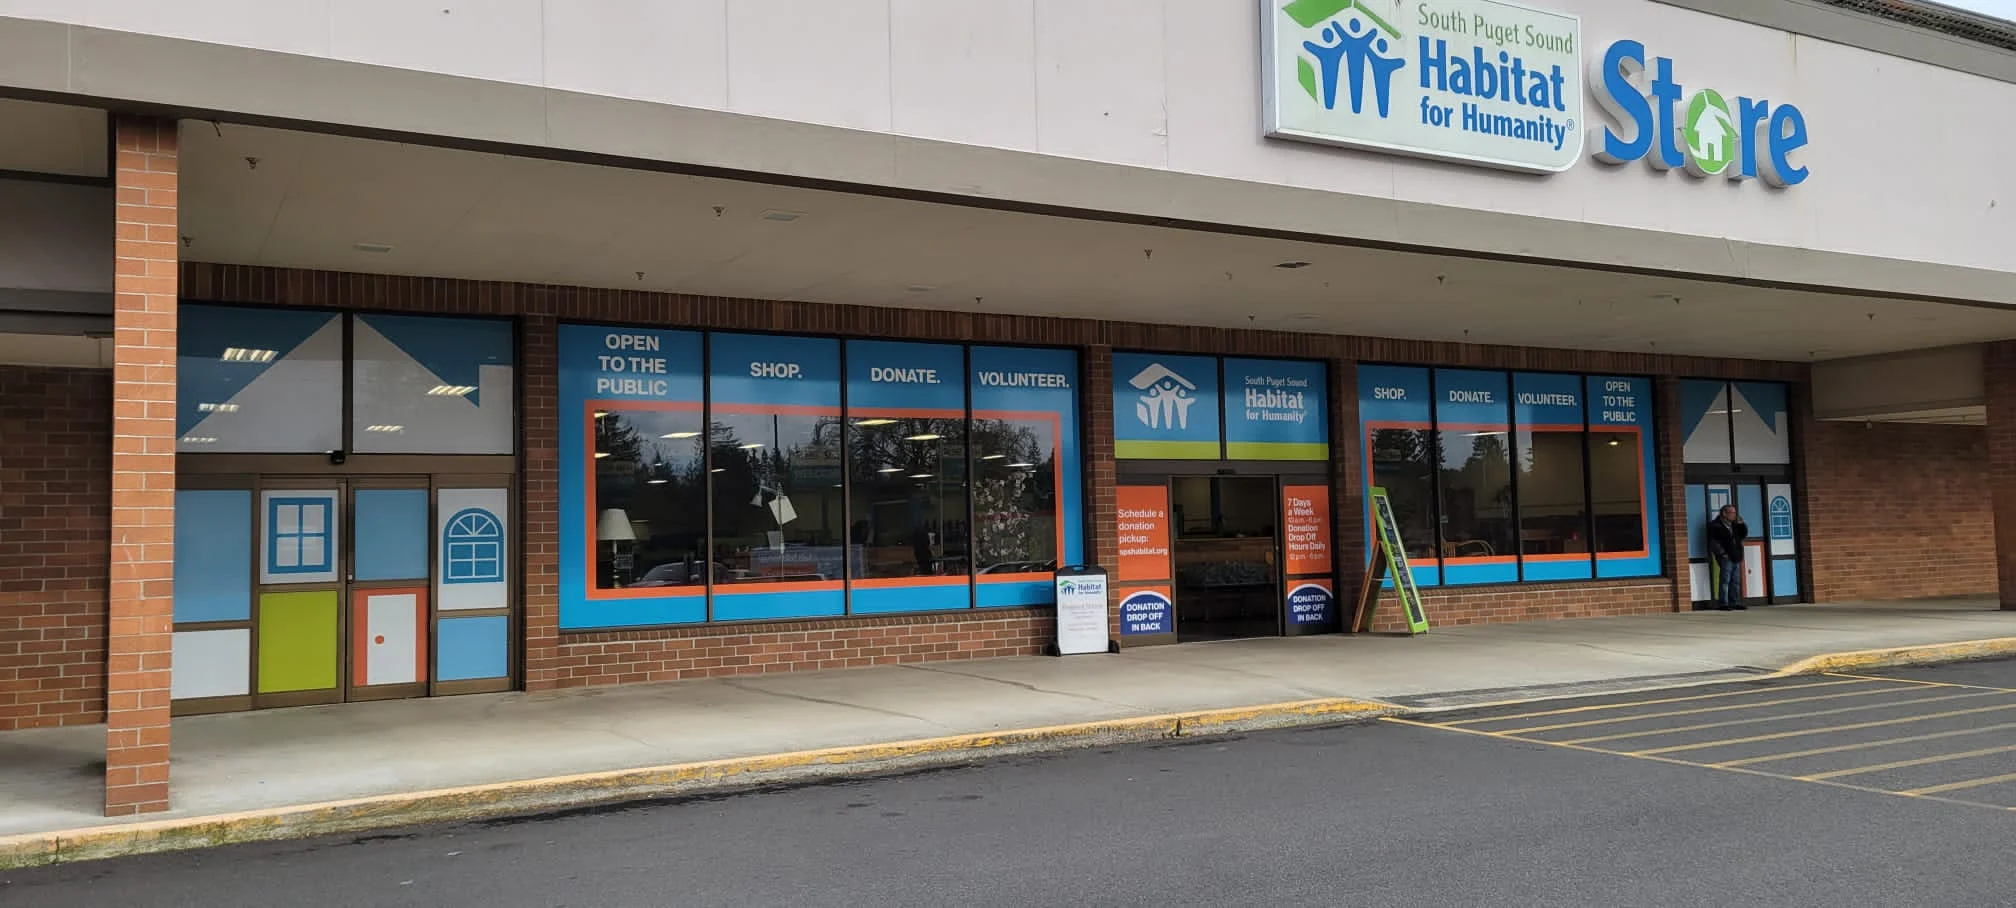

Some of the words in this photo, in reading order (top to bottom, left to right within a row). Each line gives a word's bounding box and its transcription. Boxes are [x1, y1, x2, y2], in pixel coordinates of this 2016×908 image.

[1418, 3, 1466, 34] South
[1473, 13, 1521, 46] Puget
[1525, 24, 1573, 54] Sound
[1418, 35, 1566, 112] Habitat
[1420, 95, 1453, 128] for
[1600, 38, 1810, 186] Store
[605, 333, 659, 351] OPEN
[598, 356, 625, 372] TO
[628, 357, 667, 374] THE
[750, 361, 803, 379] SHOP.
[870, 367, 941, 384] DONATE.
[978, 371, 1070, 388] VOLUNTEER.
[597, 378, 668, 396] PUBLIC
[1244, 375, 1265, 385] South
[1266, 376, 1285, 388] Puget
[1286, 376, 1308, 388] Sound
[1605, 381, 1631, 392] OPEN
[1245, 387, 1304, 409] Habitat
[1374, 387, 1407, 400] SHOP.
[1449, 390, 1495, 403] DONATE.
[1518, 393, 1577, 406] VOLUNTEER.
[1602, 395, 1616, 407] TO
[1617, 396, 1635, 407] THE
[1246, 409, 1259, 420] for
[1603, 411, 1636, 422] PUBLIC
[1287, 498, 1292, 507] 7
[1293, 497, 1312, 508] Days
[1118, 508, 1156, 518] Schedule
[1158, 510, 1164, 518] a
[1293, 508, 1314, 516] Week
[1118, 522, 1155, 531] donation
[1288, 524, 1318, 533] Donation
[1288, 533, 1305, 542] Drop
[1305, 532, 1317, 541] Off
[1288, 542, 1309, 551] Hours
[1309, 542, 1326, 552] Daily
[1077, 583, 1102, 591] Habitat
[1293, 594, 1327, 603] DONATION
[1126, 602, 1165, 612] DONATION
[1293, 604, 1312, 613] DROP
[1312, 603, 1325, 612] OFF
[1126, 613, 1148, 622] DROP
[1148, 612, 1163, 621] OFF
[1297, 614, 1305, 622] IN
[1305, 613, 1323, 622] BACK
[1131, 623, 1140, 632] IN
[1140, 622, 1161, 631] BACK
